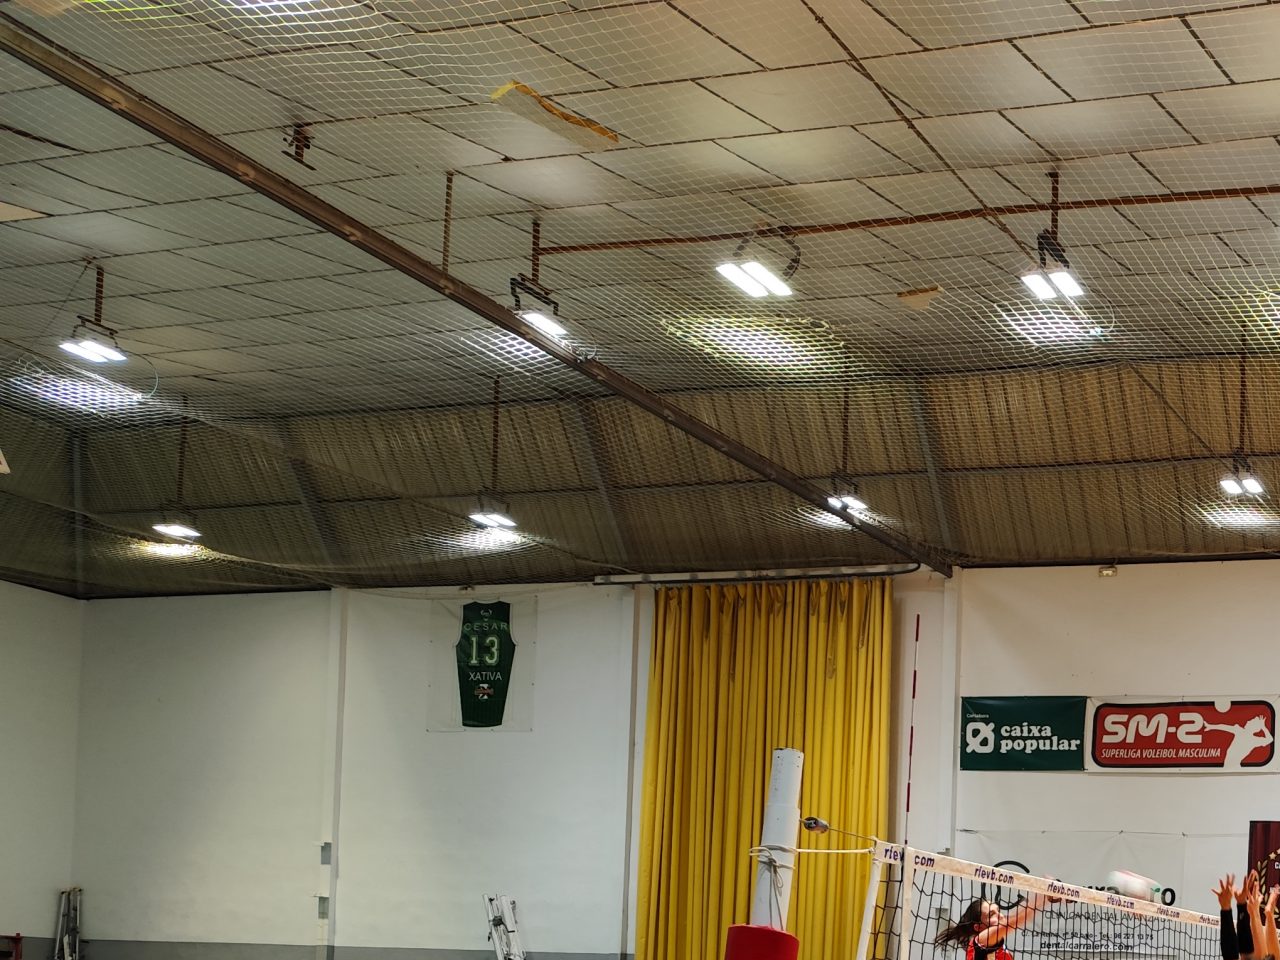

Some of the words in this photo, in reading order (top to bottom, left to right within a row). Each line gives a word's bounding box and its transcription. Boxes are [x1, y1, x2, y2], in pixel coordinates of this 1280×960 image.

[464, 622, 508, 631] CESAR
[469, 636, 499, 665] 13
[469, 672, 502, 681] XATIVA
[1001, 722, 1051, 737] caixa
[1101, 712, 1204, 744] SM-2
[1000, 736, 1080, 753] popular
[1101, 749, 1141, 758] SUPERLIGA
[1142, 748, 1177, 758] VOLEIBOL
[1177, 748, 1221, 758] MASCULINA
[974, 865, 1014, 885] rfevb.com
[1046, 881, 1080, 899] rfevb.com
